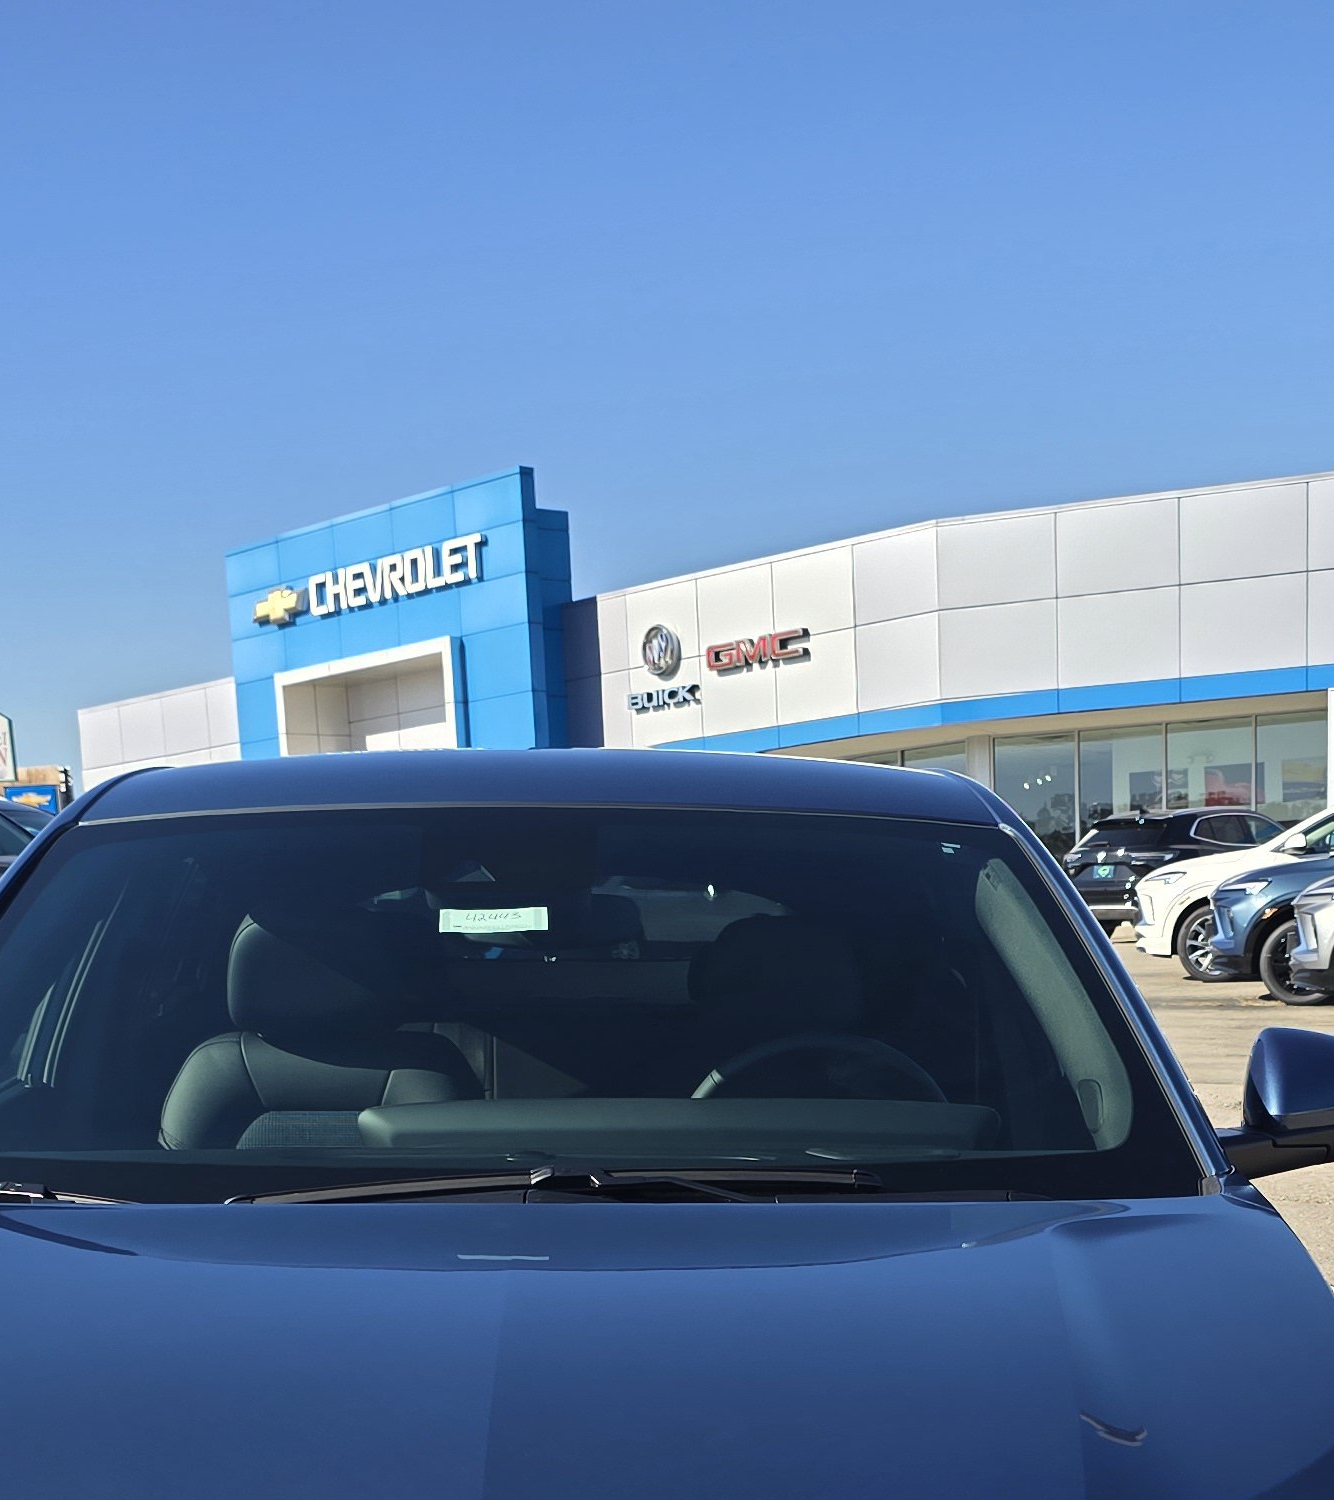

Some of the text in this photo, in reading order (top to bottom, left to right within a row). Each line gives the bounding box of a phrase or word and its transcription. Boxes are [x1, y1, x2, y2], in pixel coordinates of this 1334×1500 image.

[308, 532, 483, 617] CHEVROLET
[706, 628, 807, 672] GMC
[626, 683, 695, 711] BUICK
